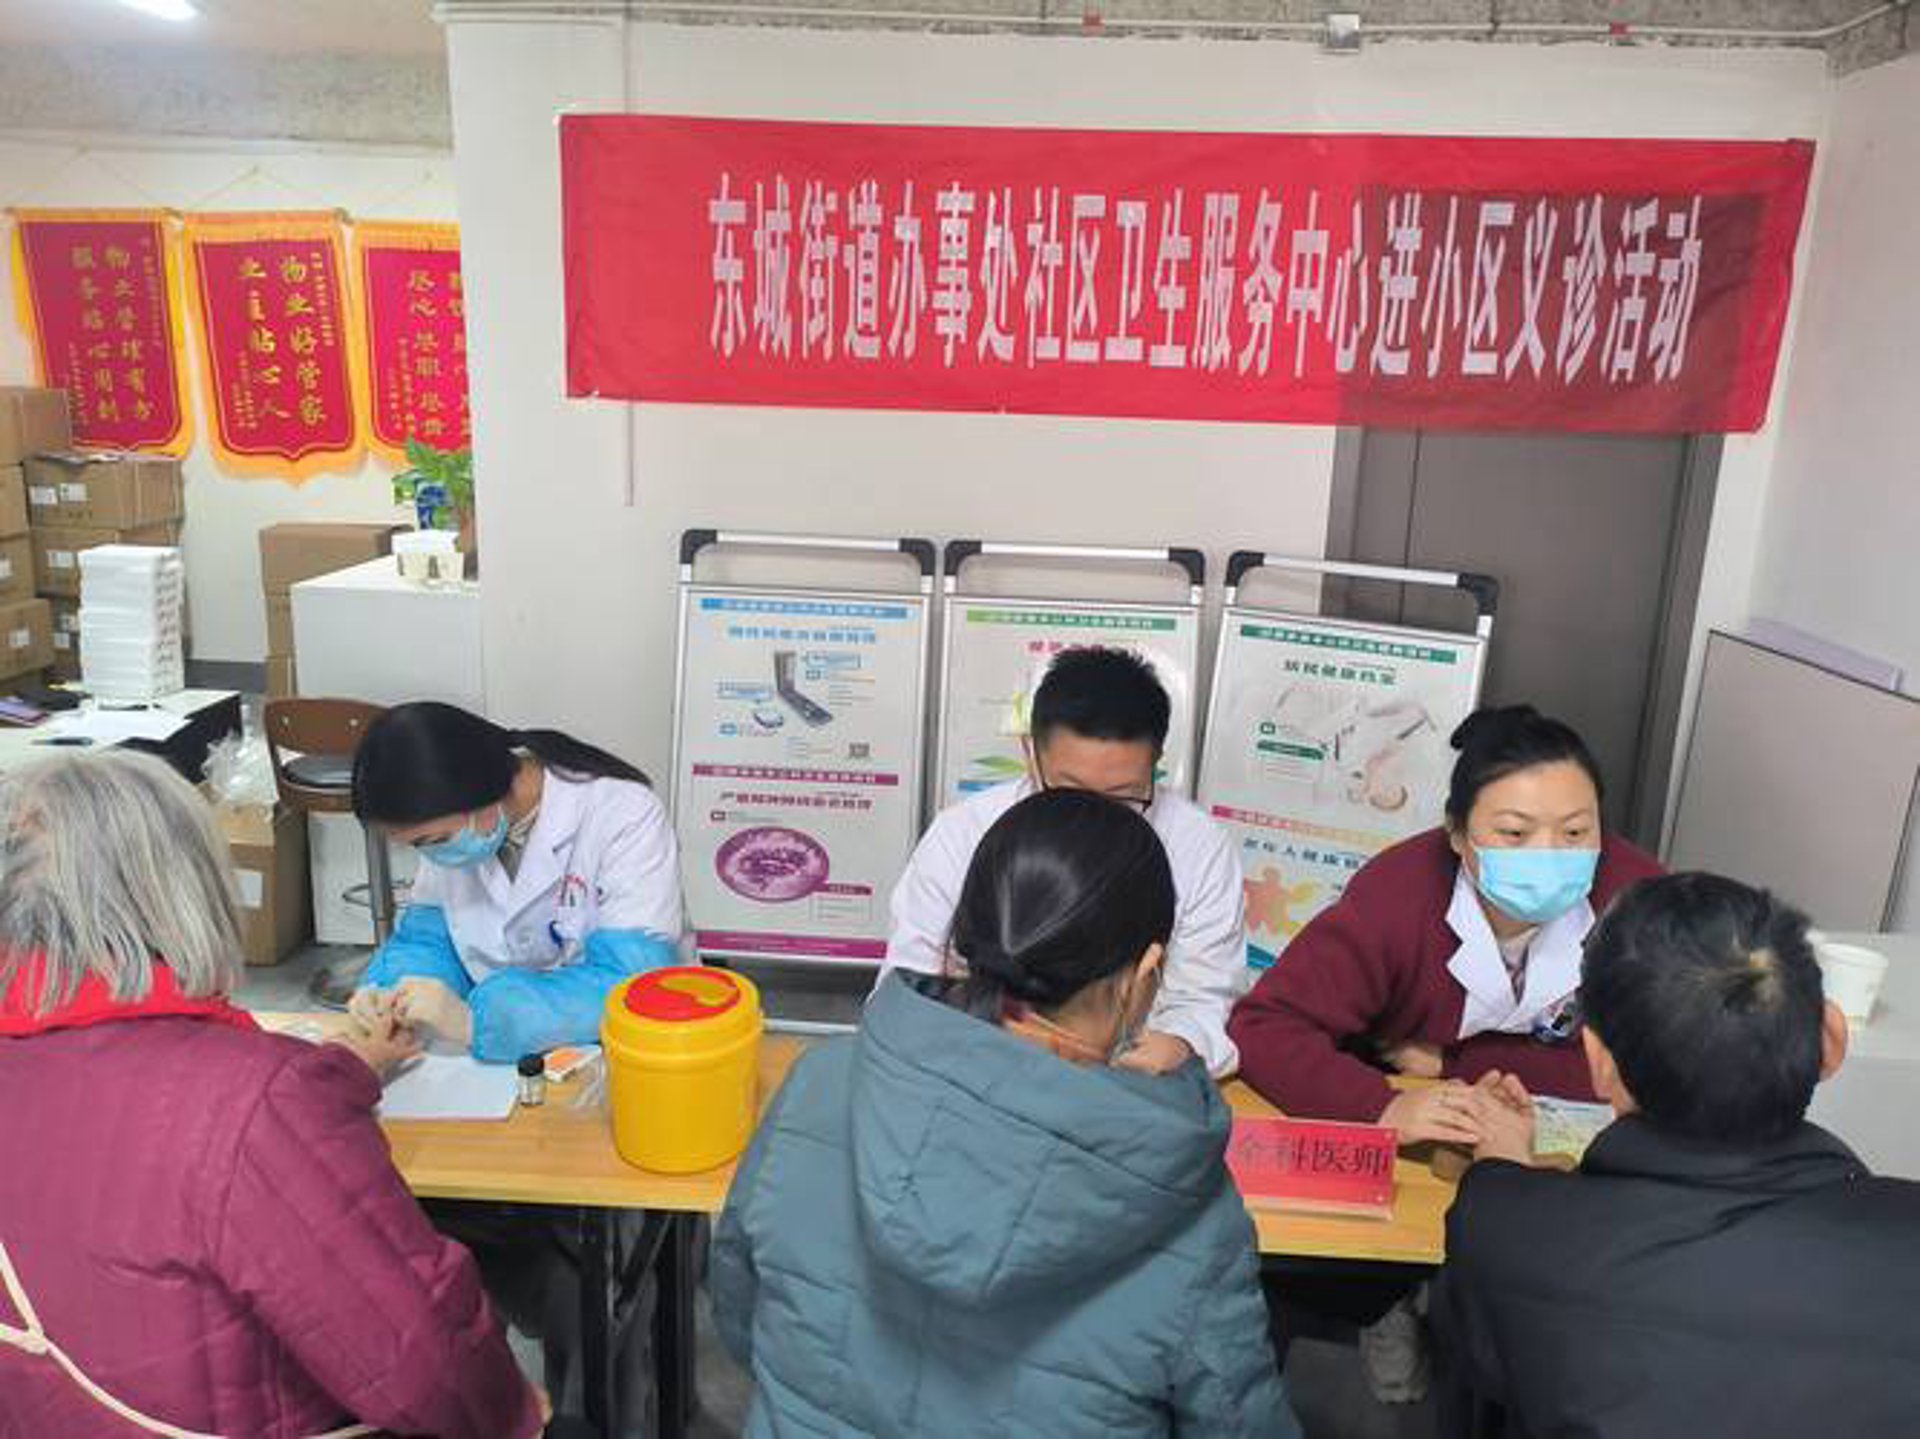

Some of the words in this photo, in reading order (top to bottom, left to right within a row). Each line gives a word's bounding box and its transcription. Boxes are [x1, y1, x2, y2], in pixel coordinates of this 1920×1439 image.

[238, 256, 291, 419] 业主贴心人
[280, 255, 327, 427] 物业好管家
[709, 173, 1703, 386] 东城街道办事处社区卫生服务中心进小区义诊活动
[1283, 658, 1396, 686] 居民健康档案
[1240, 1136, 1390, 1177] 全科医师
